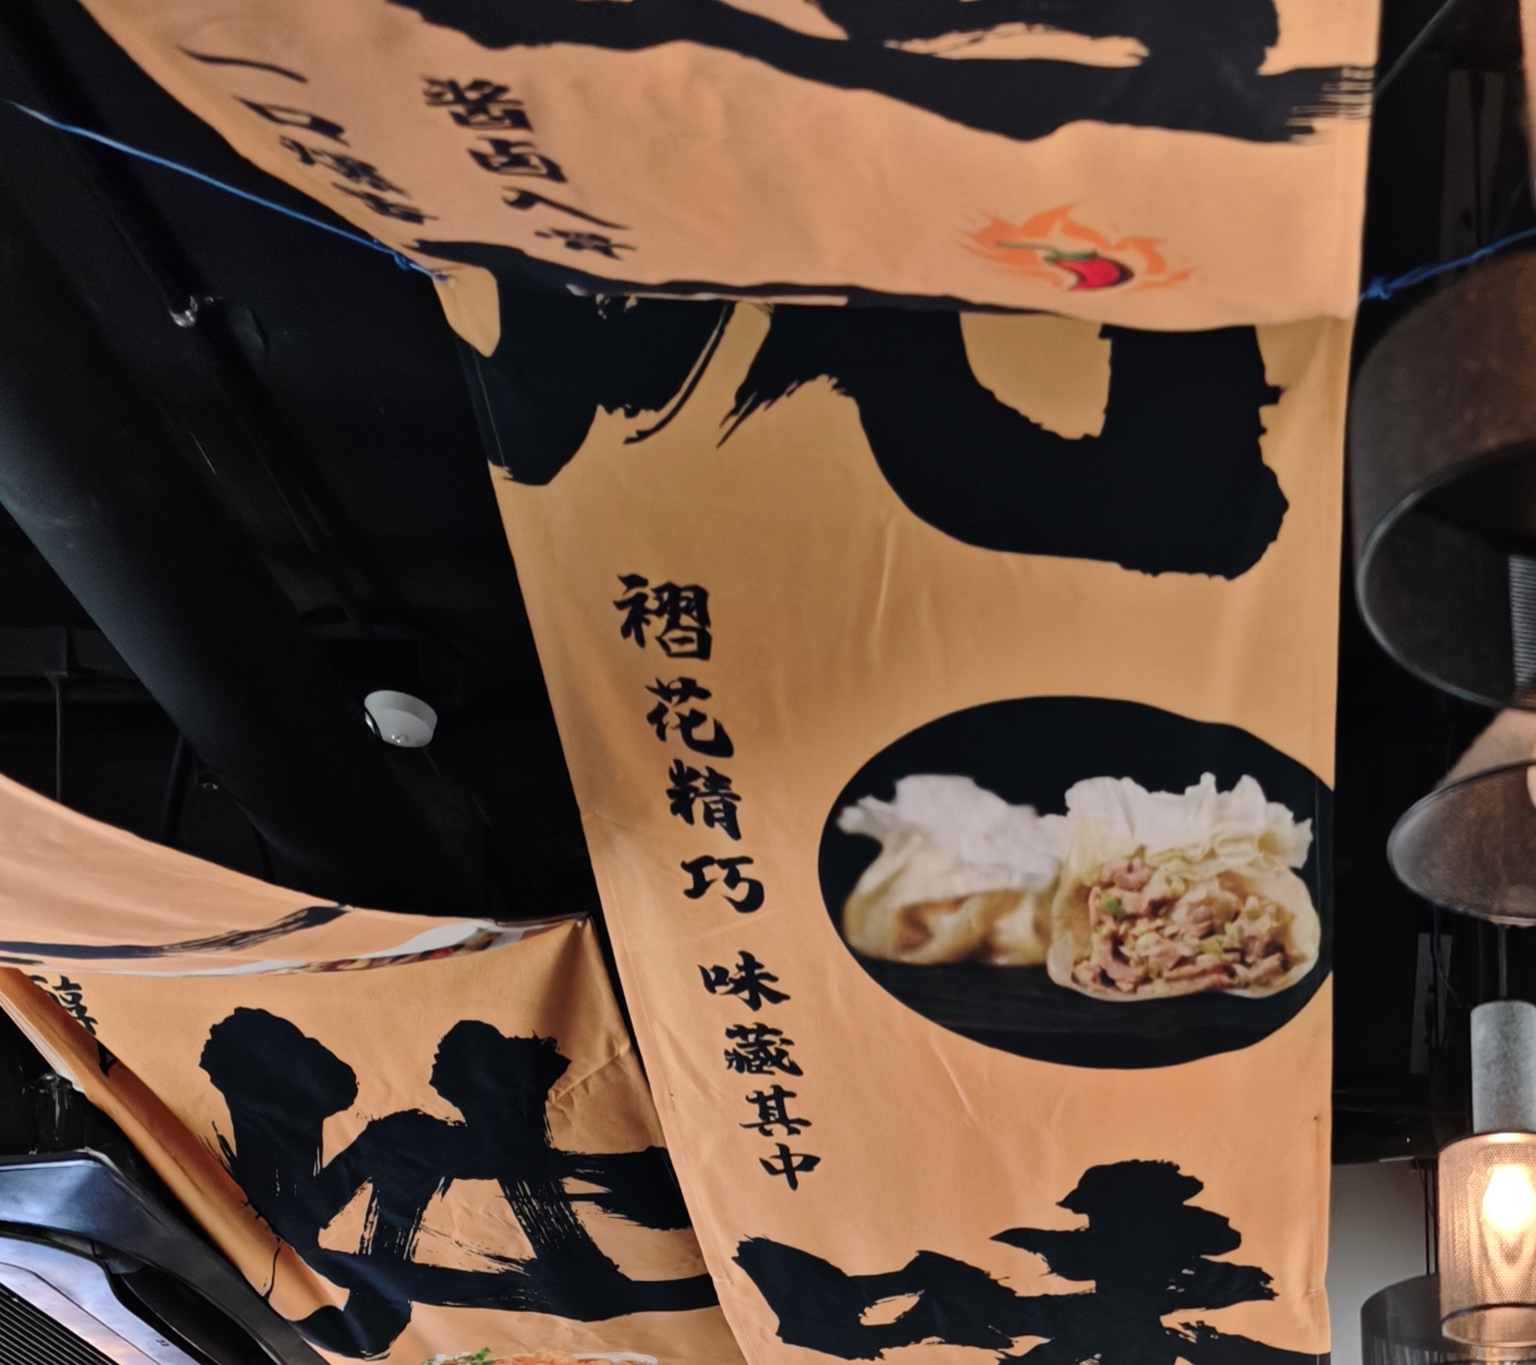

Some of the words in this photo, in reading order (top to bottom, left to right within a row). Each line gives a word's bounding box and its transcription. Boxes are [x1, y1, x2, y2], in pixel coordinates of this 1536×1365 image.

[612, 572, 766, 915] 褶花精巧
[698, 948, 823, 1193] 味藏其中
